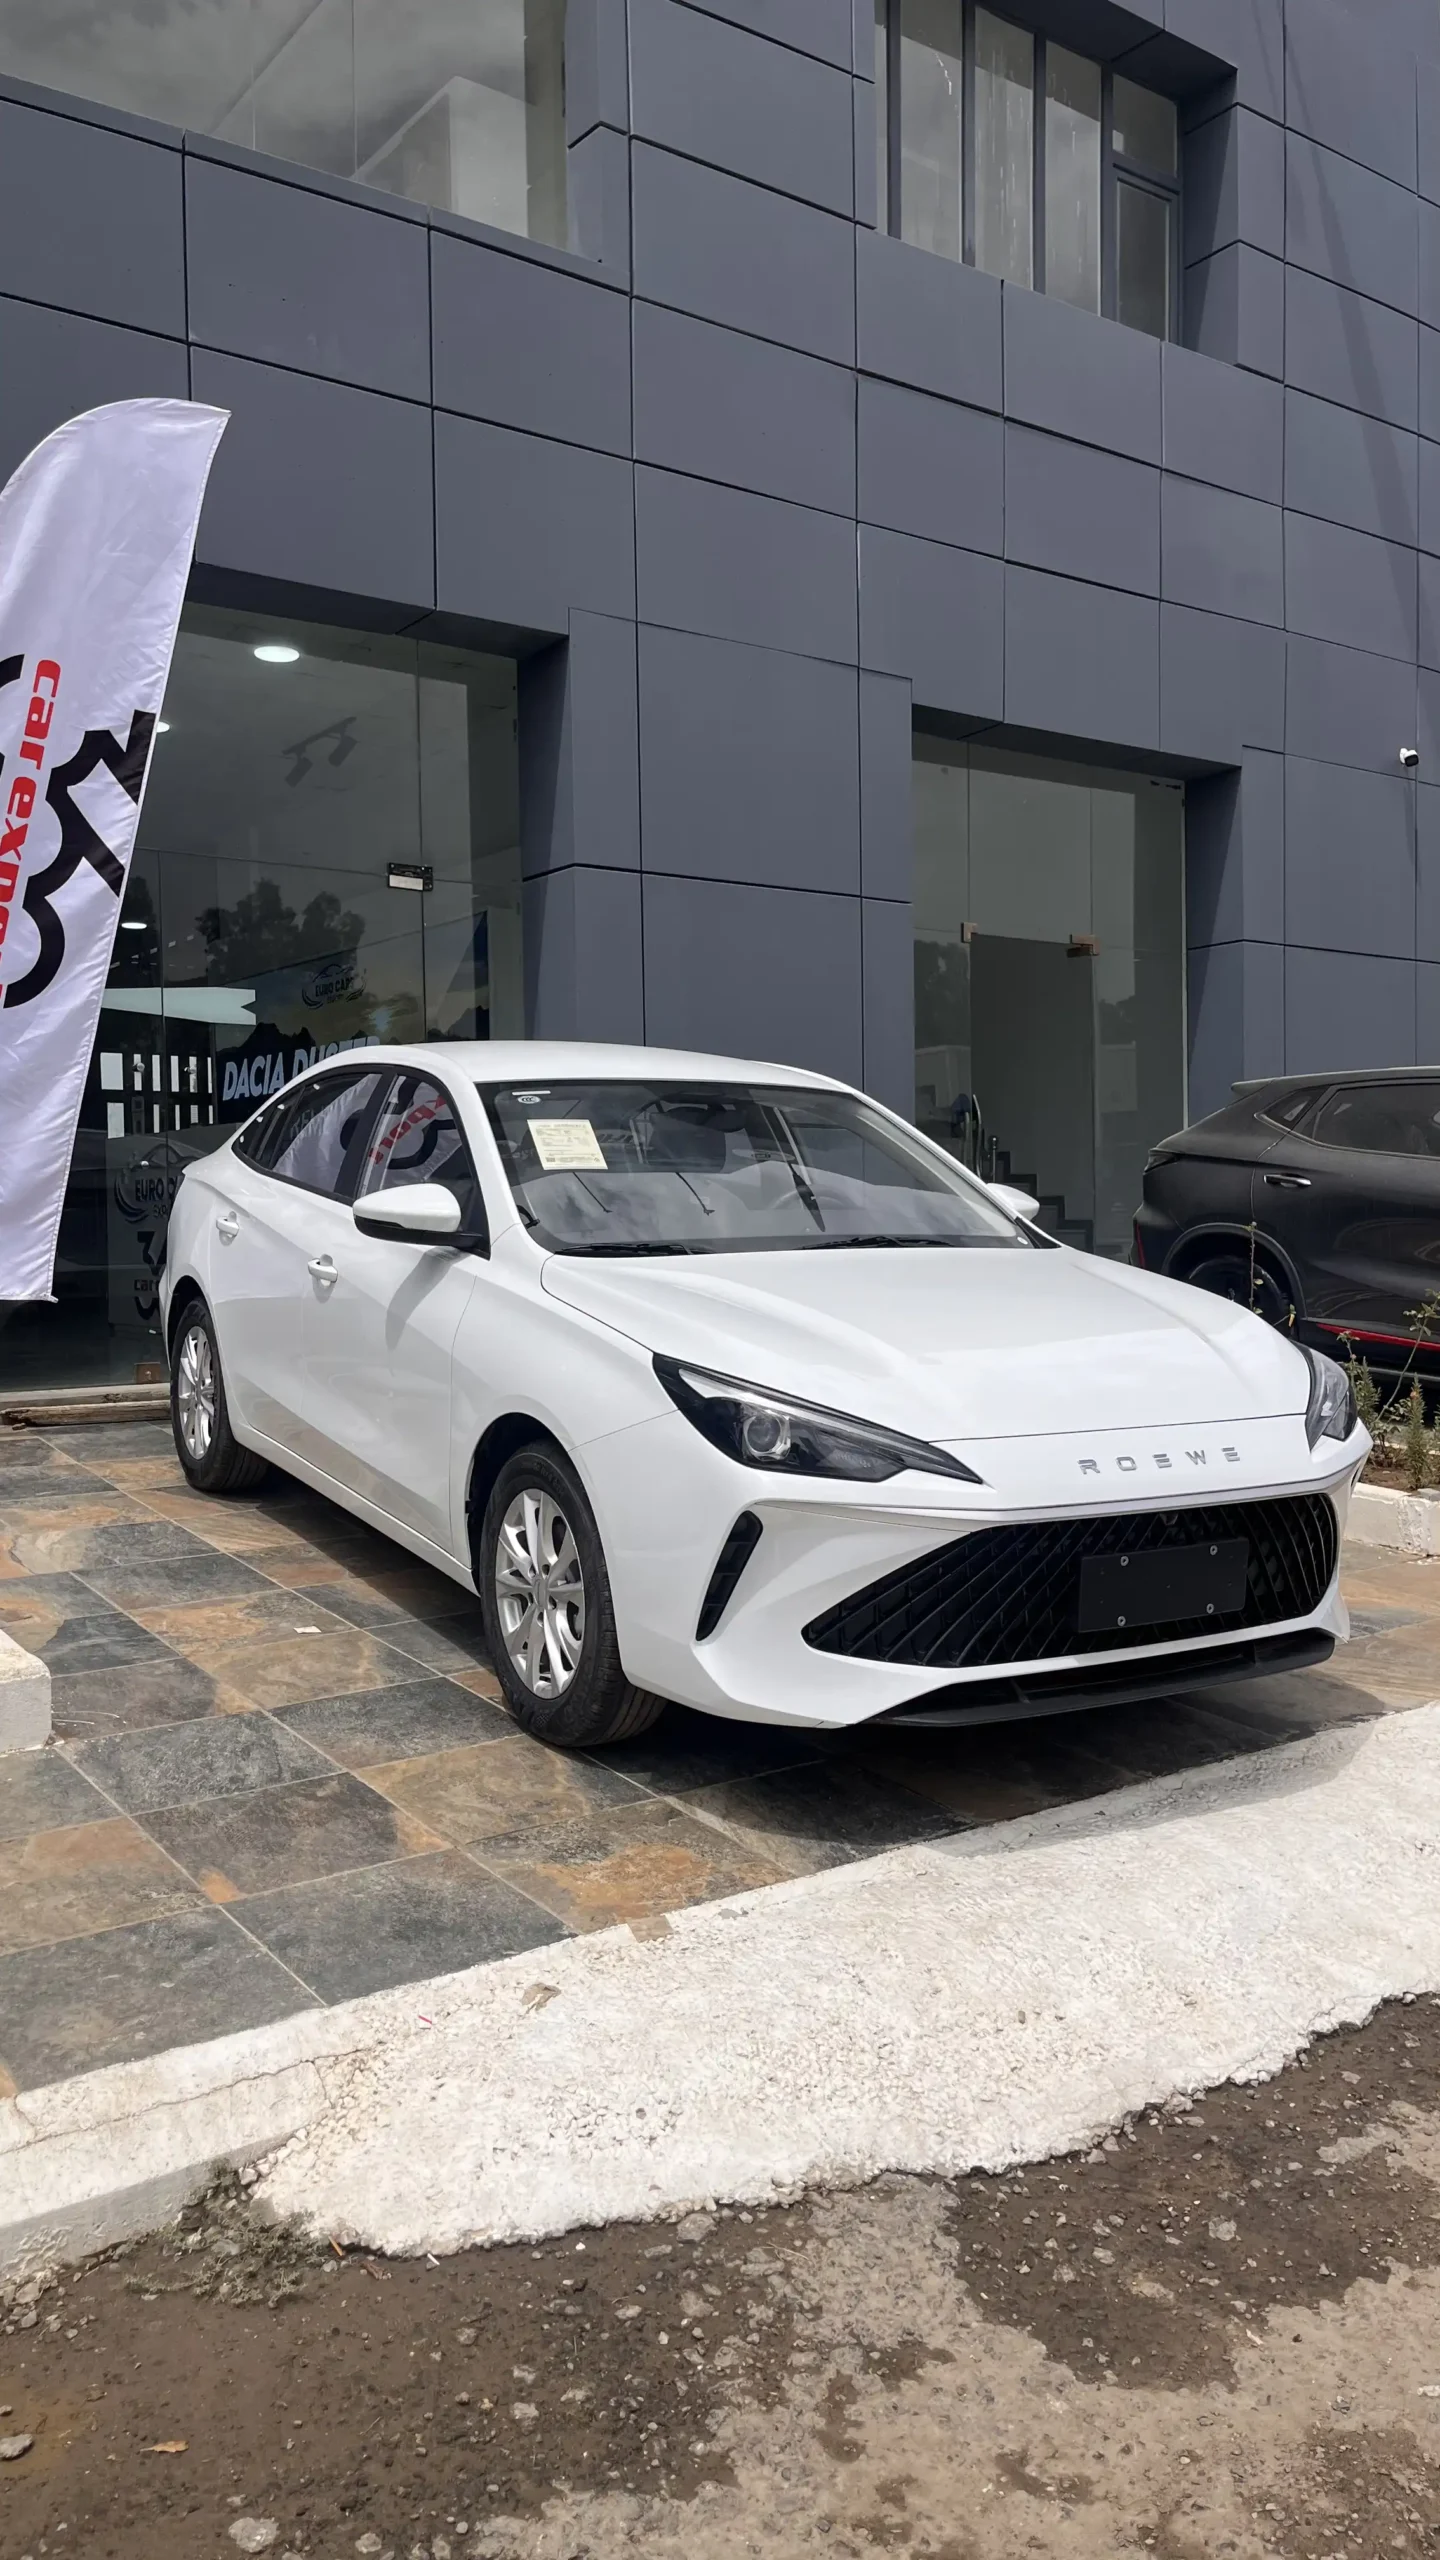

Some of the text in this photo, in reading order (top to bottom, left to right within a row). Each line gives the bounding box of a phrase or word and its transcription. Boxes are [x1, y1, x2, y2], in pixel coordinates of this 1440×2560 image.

[0, 659, 61, 1001] car exp
[222, 1052, 285, 1101] DACIA
[135, 1176, 165, 1202] EURO
[1077, 1446, 1241, 1475] ROEWE
